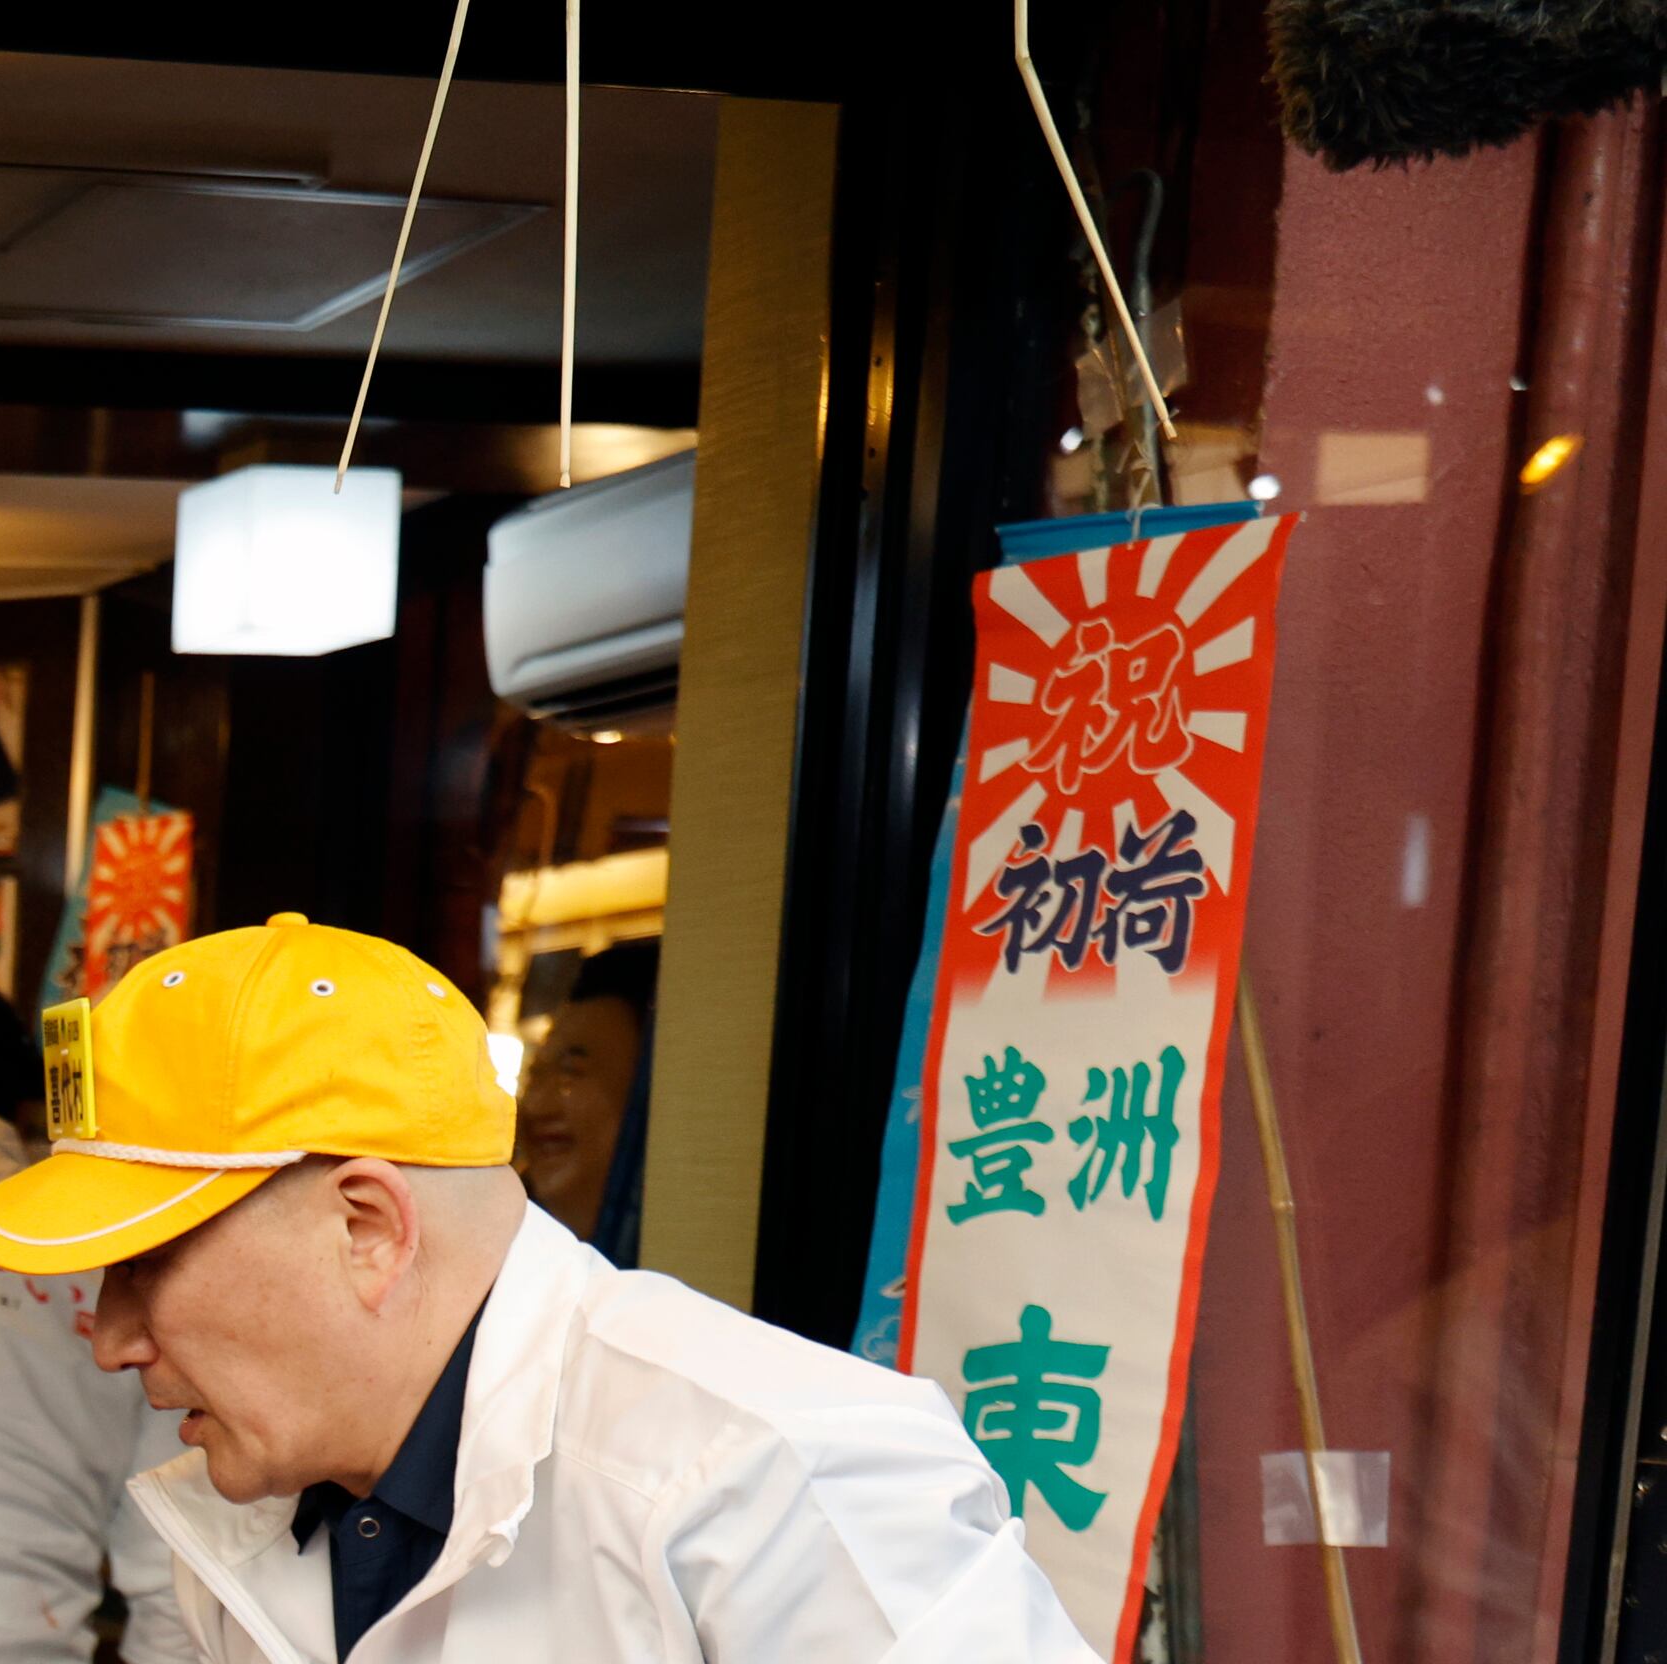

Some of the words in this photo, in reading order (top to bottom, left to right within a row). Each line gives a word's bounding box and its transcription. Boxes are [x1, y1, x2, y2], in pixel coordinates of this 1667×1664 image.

[1022, 615, 1192, 793] 祝
[974, 809, 1209, 977] 初荷
[945, 1043, 1186, 1225] 豊洲
[961, 1302, 1113, 1534] 東
